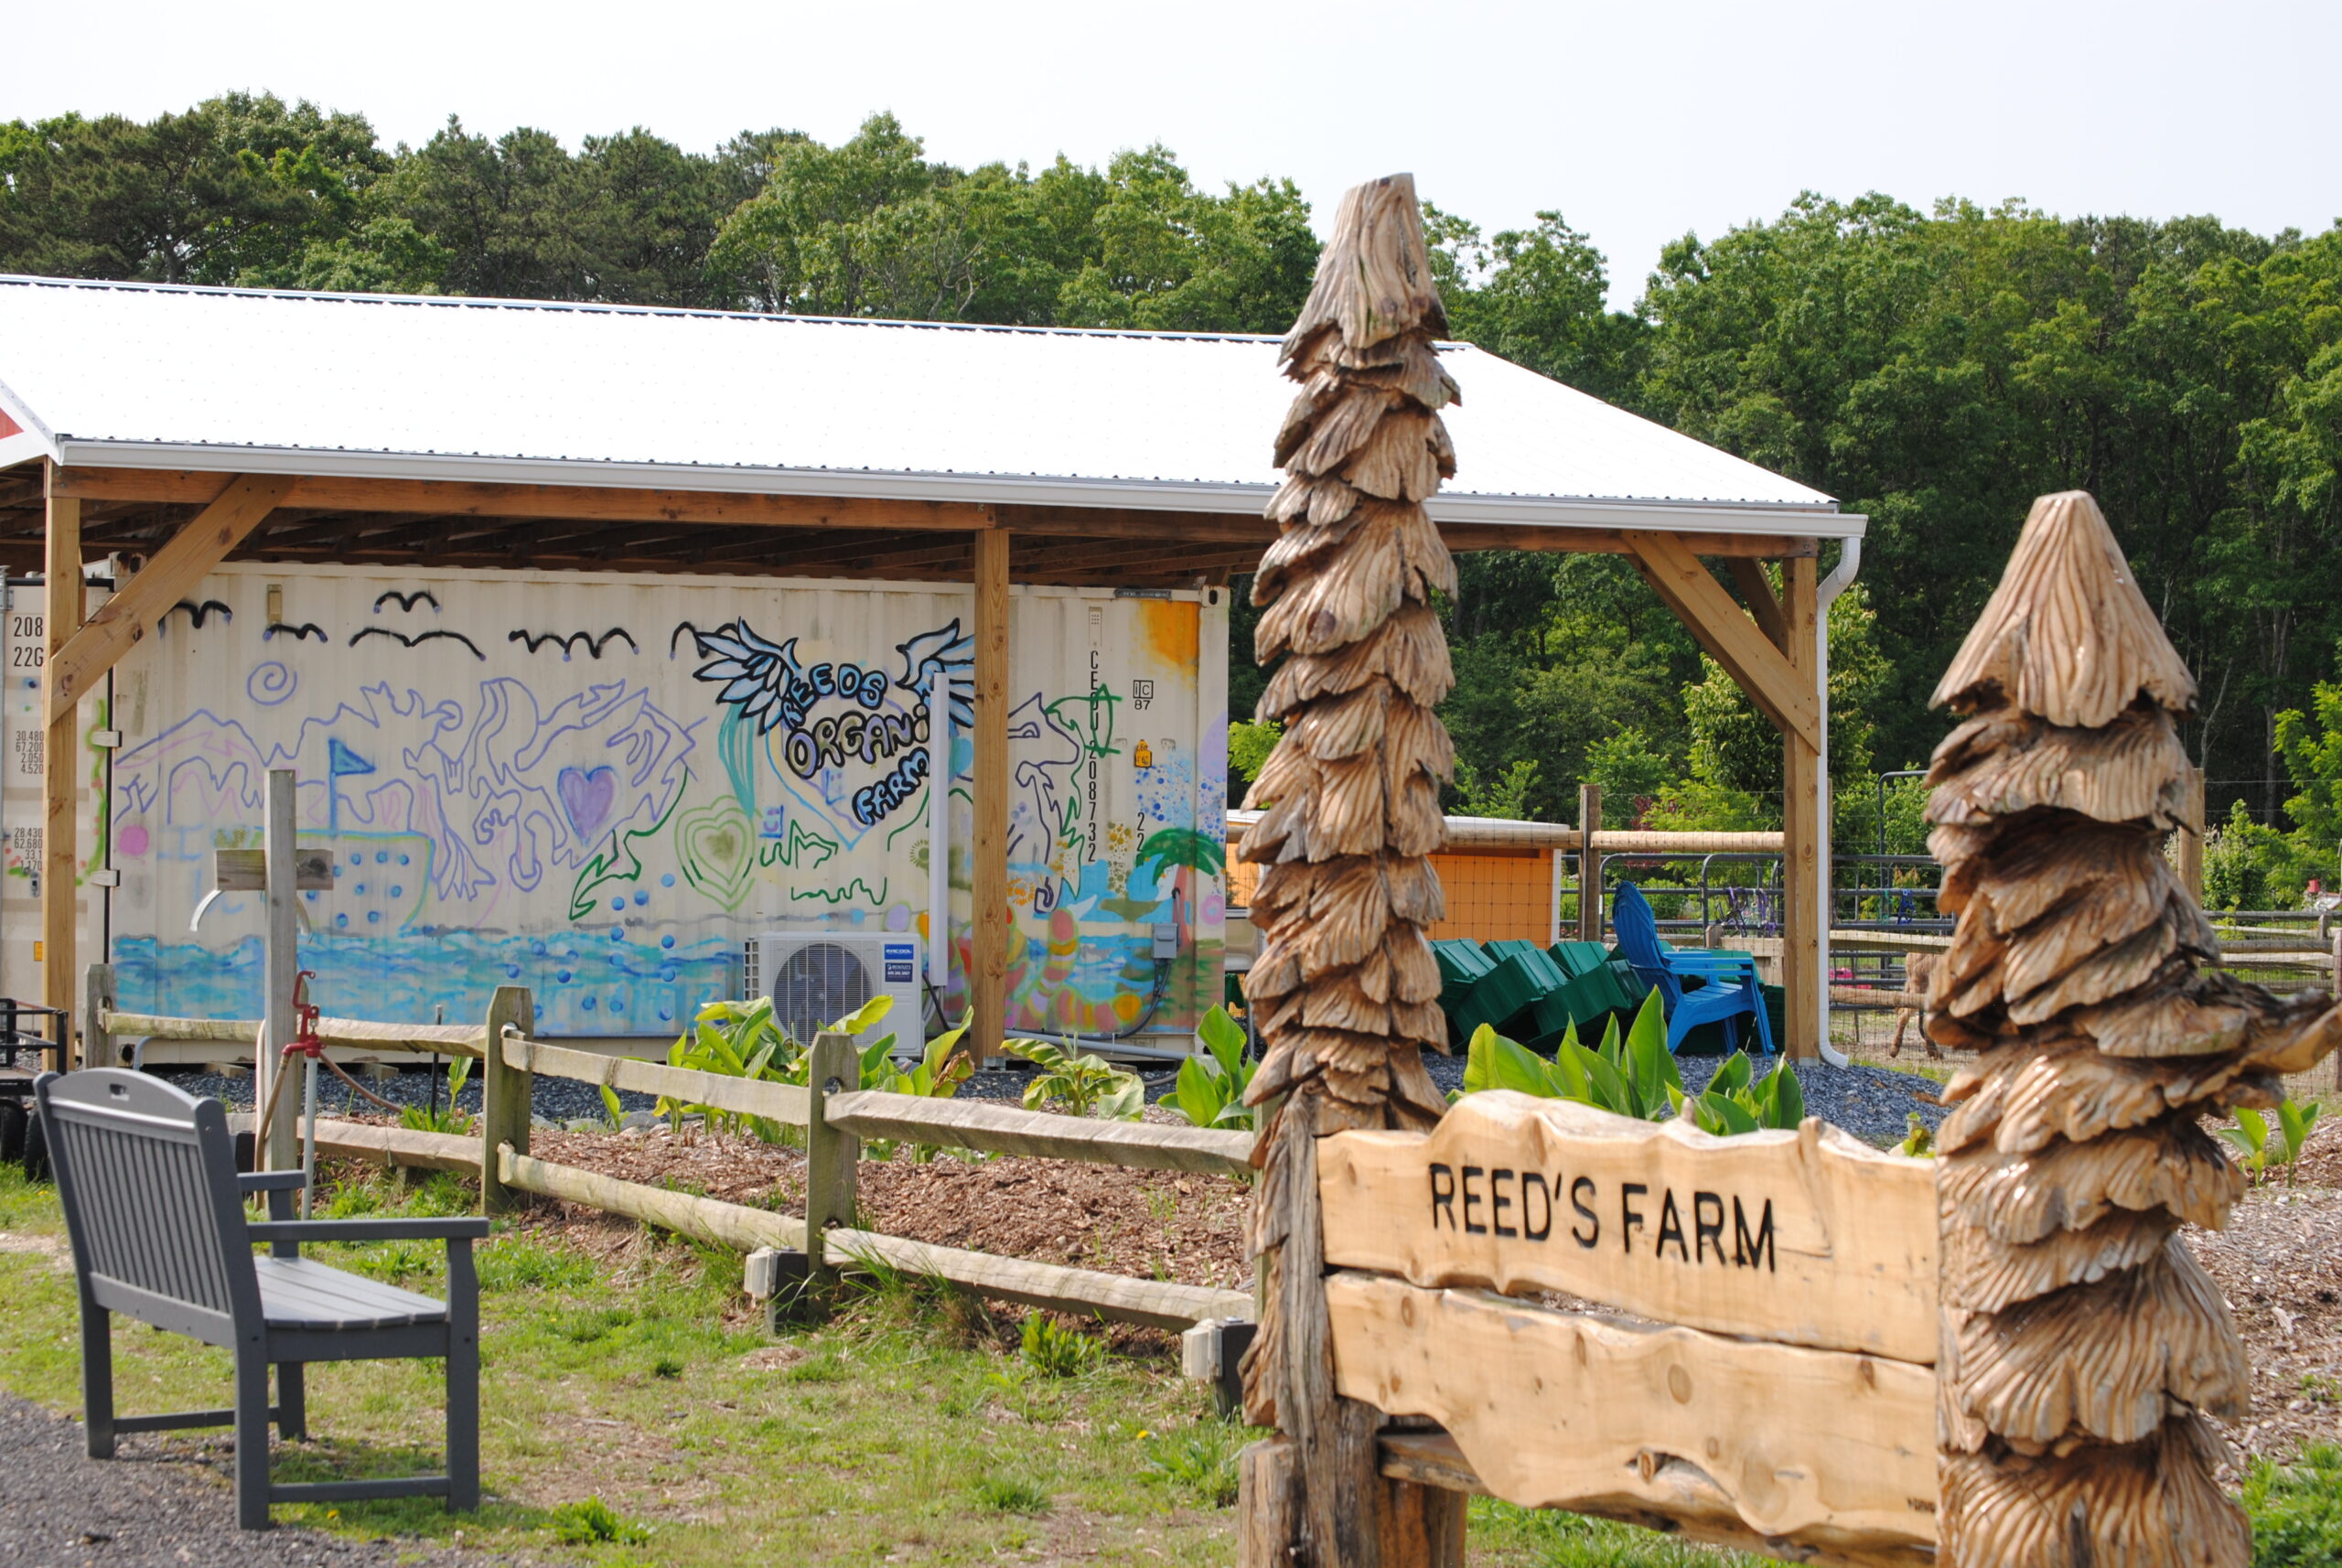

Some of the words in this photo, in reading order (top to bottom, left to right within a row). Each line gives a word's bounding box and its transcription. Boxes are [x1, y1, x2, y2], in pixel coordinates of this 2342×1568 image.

[781, 663, 888, 731] REEDS
[1134, 700, 1151, 710] 87
[1428, 1162, 1600, 1250] REED'S
[1621, 1182, 1776, 1273] FARM
